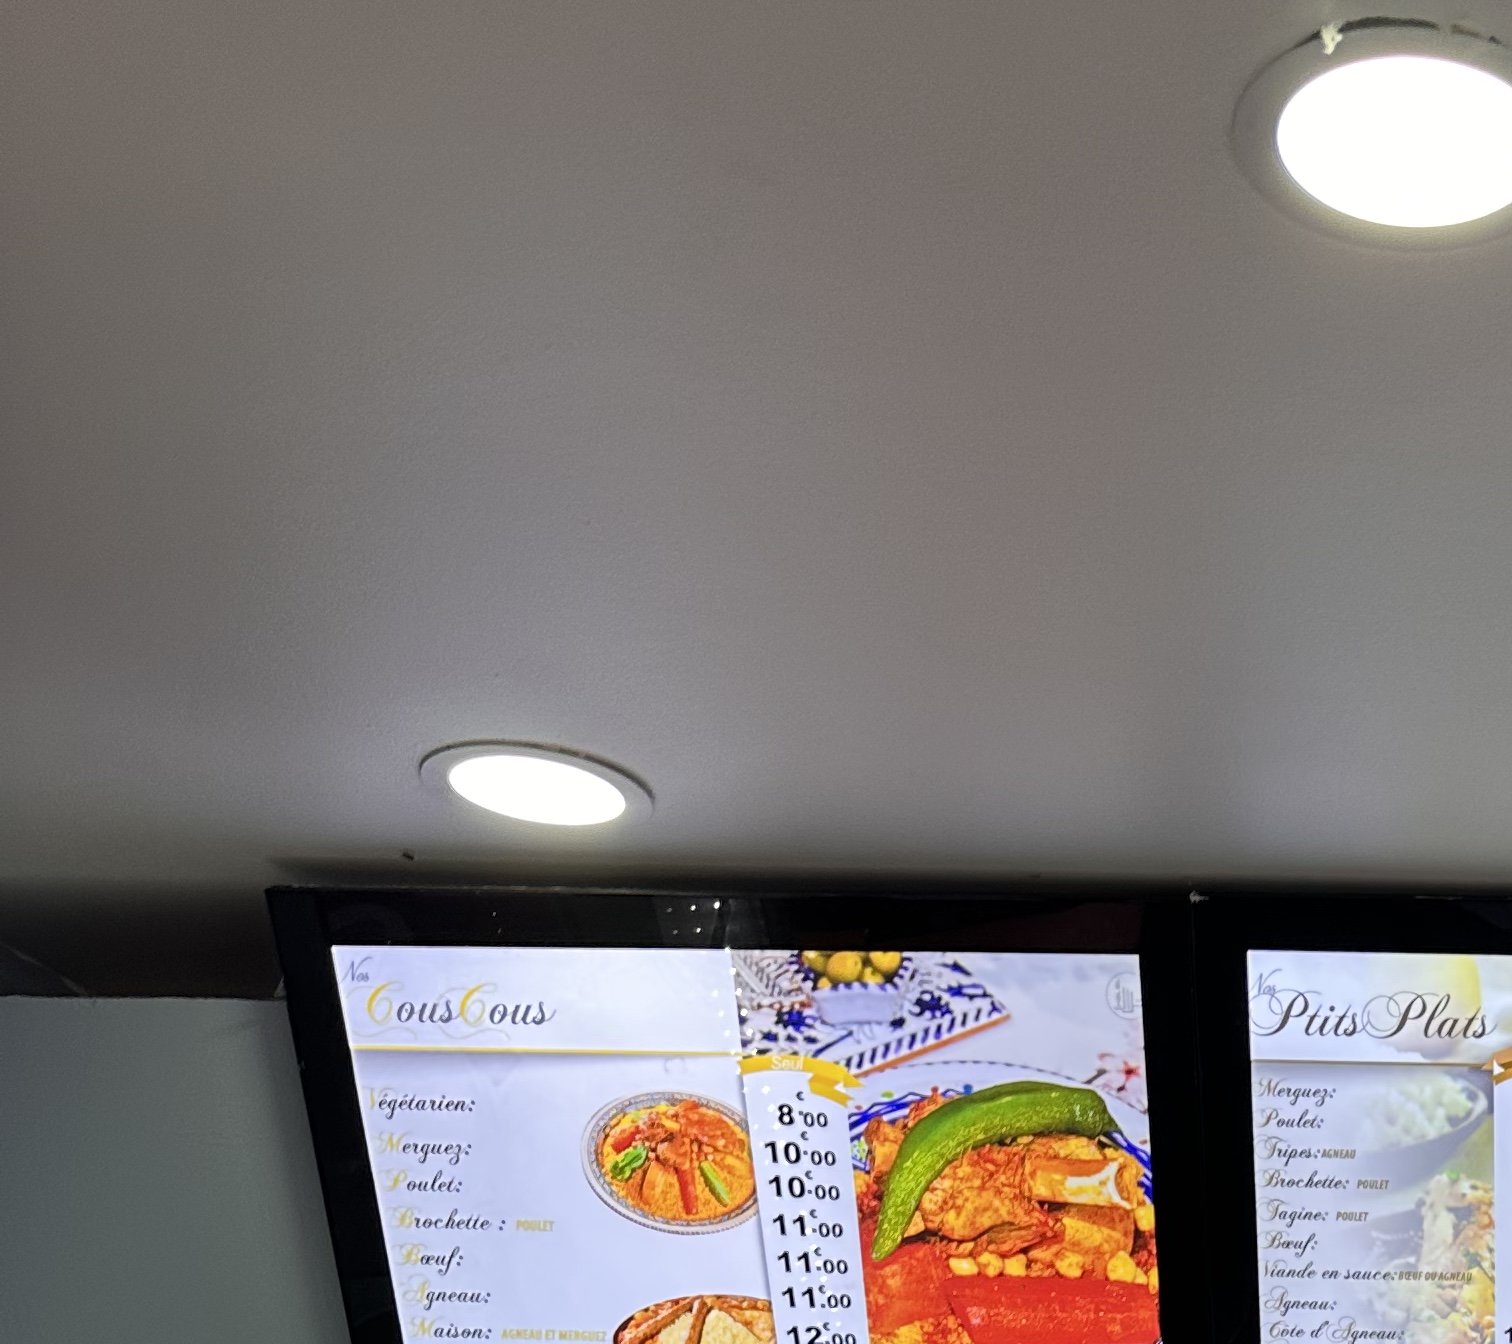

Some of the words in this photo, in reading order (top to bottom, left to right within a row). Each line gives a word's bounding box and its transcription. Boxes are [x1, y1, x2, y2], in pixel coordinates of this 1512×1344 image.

[1361, 991, 1498, 1039] Plats
[772, 1057, 804, 1070] Seul
[364, 1087, 476, 1118] Végétarien:
[1256, 1078, 1336, 1105] Merguez:
[1256, 1109, 1324, 1129] Poulet:
[375, 1132, 472, 1164] Merguez:
[1255, 1135, 1321, 1166] Tripes:
[1322, 1149, 1356, 1159] AGNEAU
[381, 1169, 461, 1194] Poulet:
[1256, 1169, 1349, 1190] Brochette:
[1357, 1180, 1389, 1190] POULET
[391, 1206, 491, 1231] Brochette
[516, 1219, 553, 1231] POULET
[1256, 1200, 1328, 1227] Tagine:
[1336, 1212, 1368, 1222] POULET
[1257, 1231, 1318, 1258] Bœuf:
[1322, 1271, 1339, 1279] en
[1344, 1266, 1397, 1281] sauce:
[403, 1274, 491, 1310] Agneau:
[1262, 1286, 1337, 1319] Agneau:
[408, 1315, 492, 1340] Maison:
[1269, 1322, 1305, 1339] Côte
